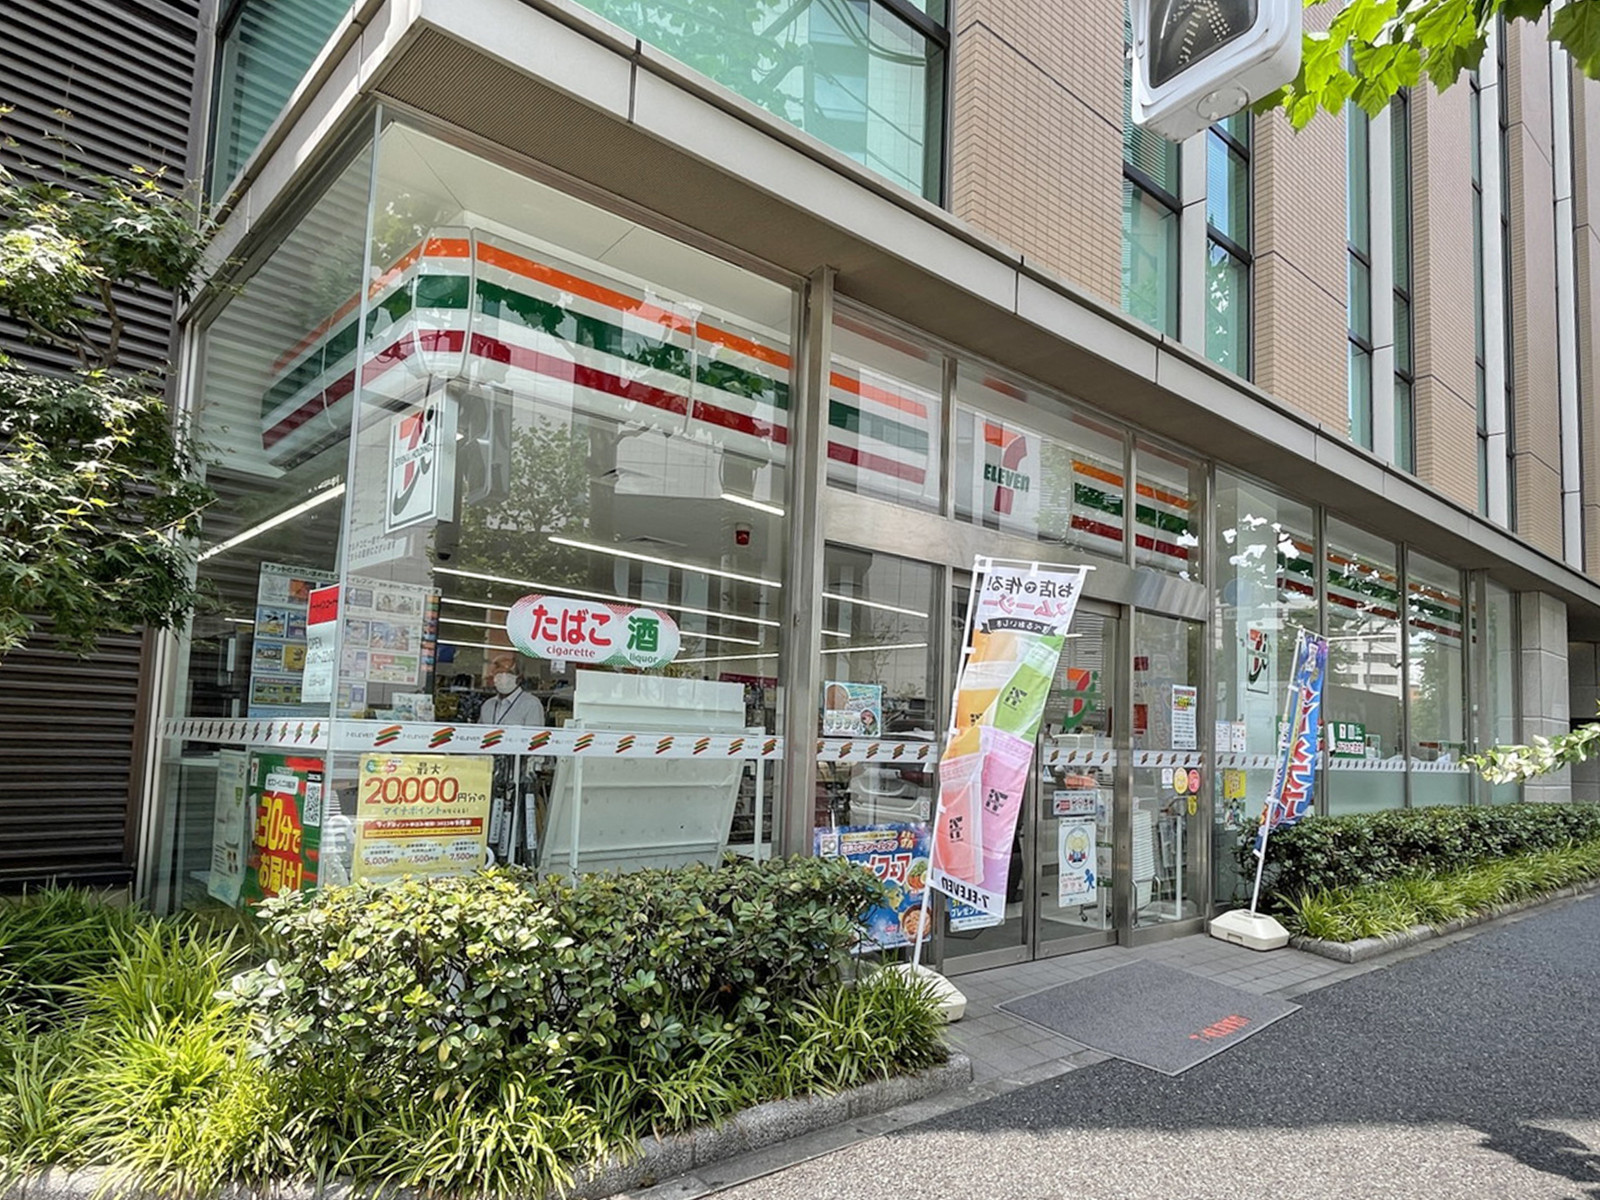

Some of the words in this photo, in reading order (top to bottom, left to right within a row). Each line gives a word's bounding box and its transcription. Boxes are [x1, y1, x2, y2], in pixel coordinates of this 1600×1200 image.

[531, 604, 611, 646] たばこ
[627, 615, 660, 652] 酒
[546, 645, 596, 658] cigarette
[629, 652, 658, 664] liquor
[417, 762, 441, 775] 最大
[254, 796, 302, 854] 30分で
